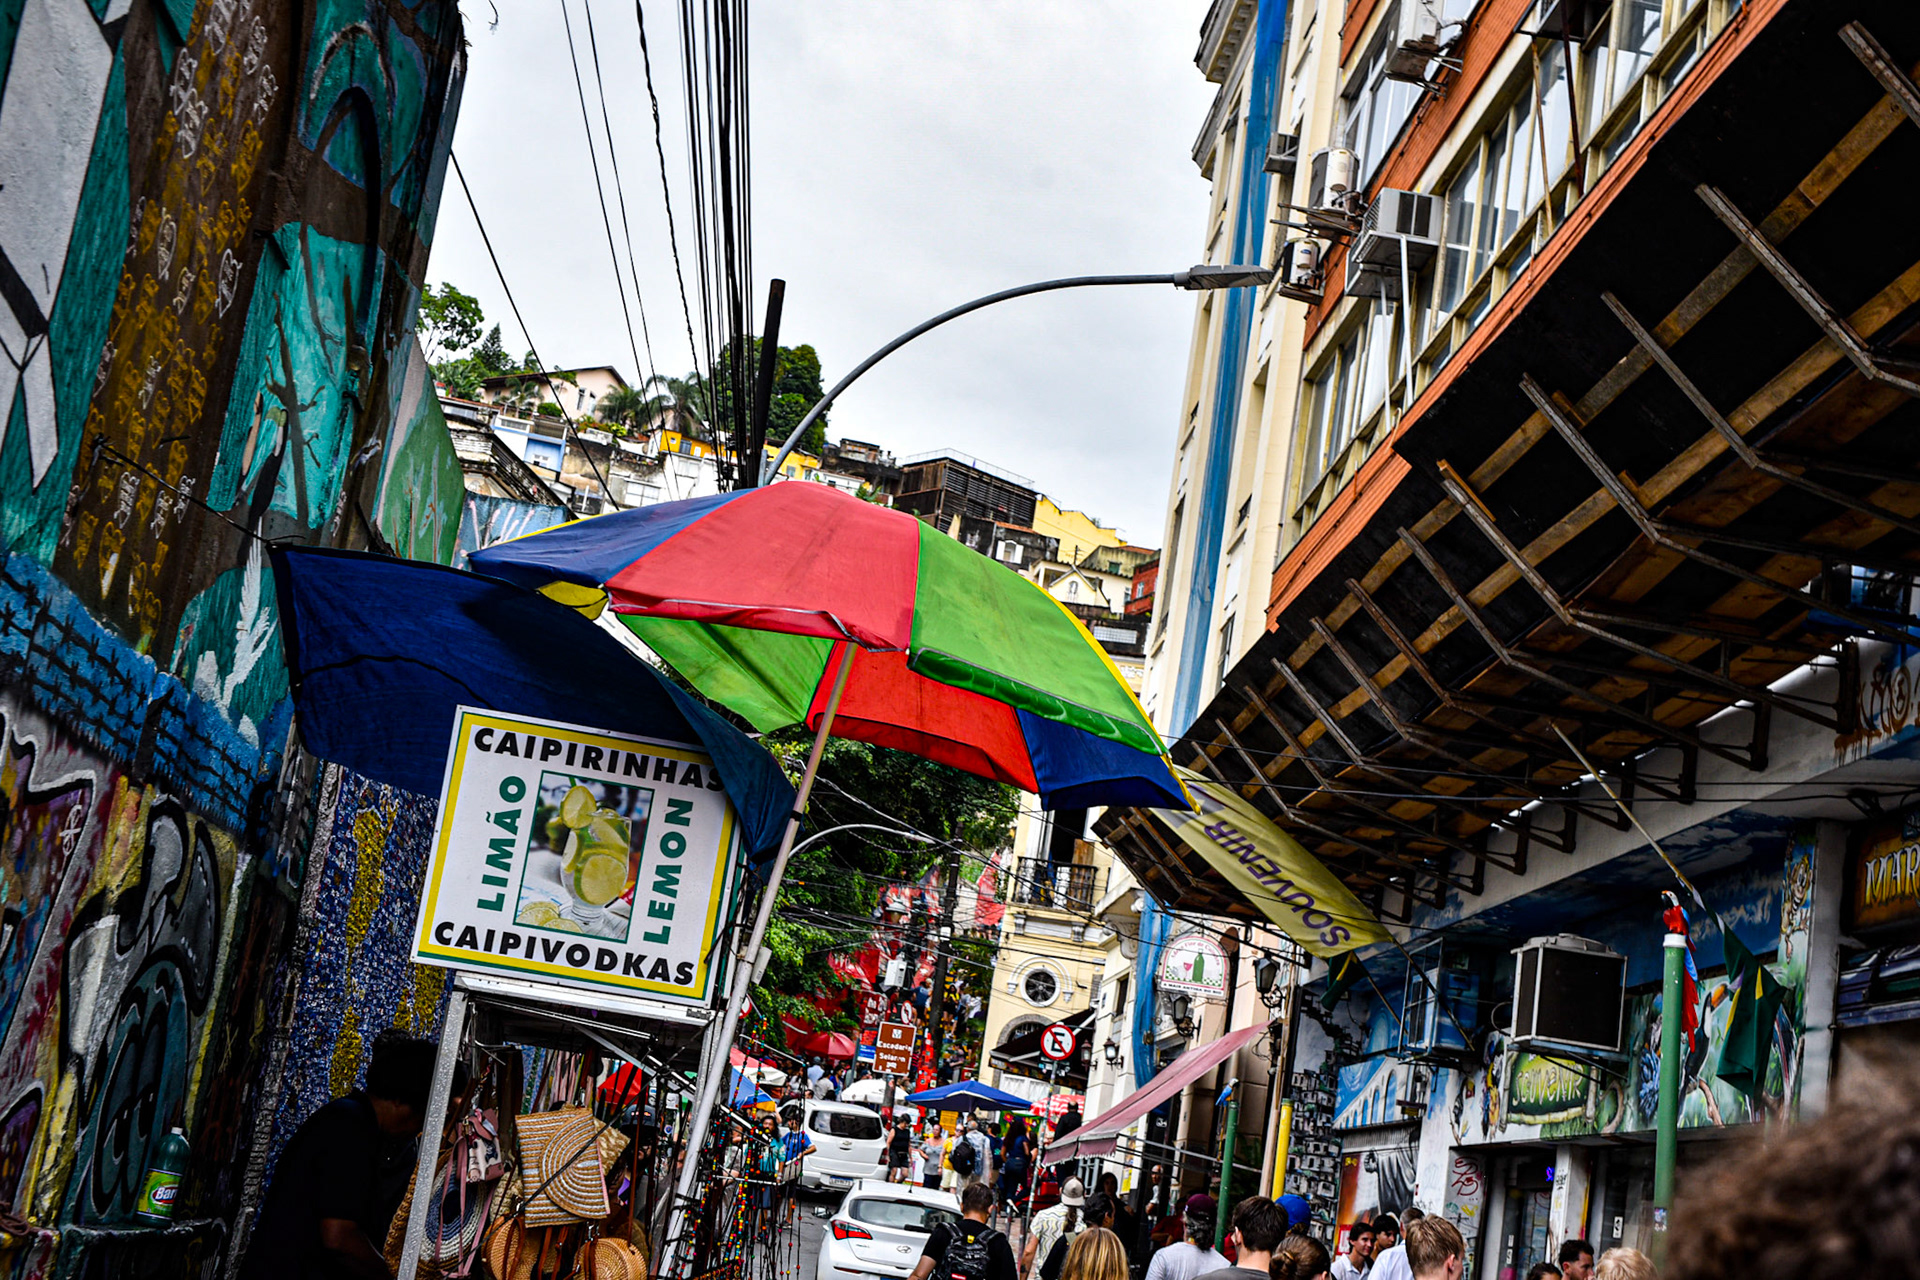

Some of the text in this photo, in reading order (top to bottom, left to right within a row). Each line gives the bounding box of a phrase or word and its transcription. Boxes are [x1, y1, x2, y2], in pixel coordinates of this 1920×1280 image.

[474, 728, 725, 792] CAIPIRINHAS
[477, 776, 527, 912] LIMÃO
[643, 798, 694, 945] LEMON
[1204, 821, 1351, 947] SOUVENIR
[434, 921, 694, 986] CAIPIVODKAS
